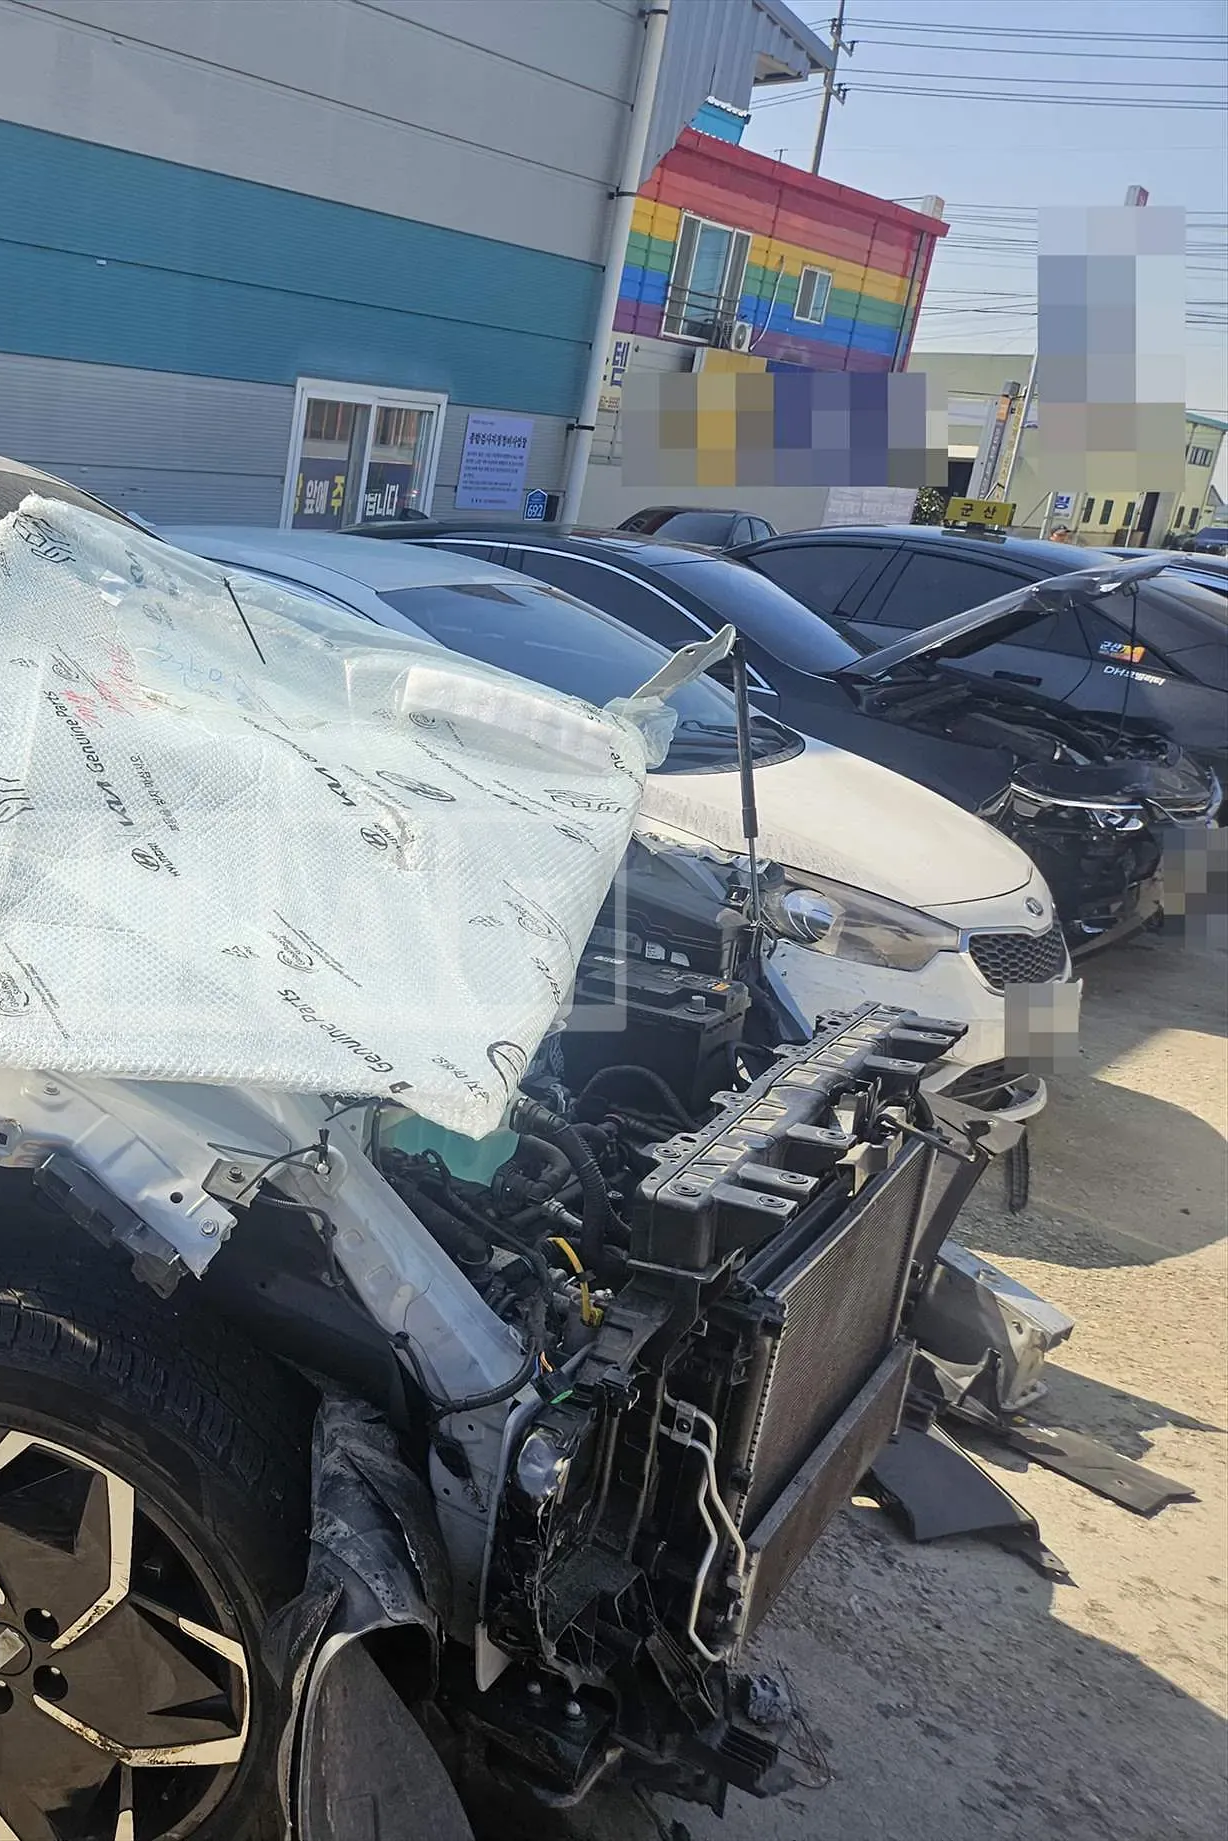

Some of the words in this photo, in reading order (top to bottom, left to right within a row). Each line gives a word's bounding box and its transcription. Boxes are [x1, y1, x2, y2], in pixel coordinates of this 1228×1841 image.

[527, 504, 544, 517] 692
[44, 690, 75, 720] Parts
[67, 718, 105, 773] Genuine
[148, 842, 181, 878] HYUNDAI
[277, 989, 325, 1023] Parts
[320, 1023, 394, 1073] Genuine
